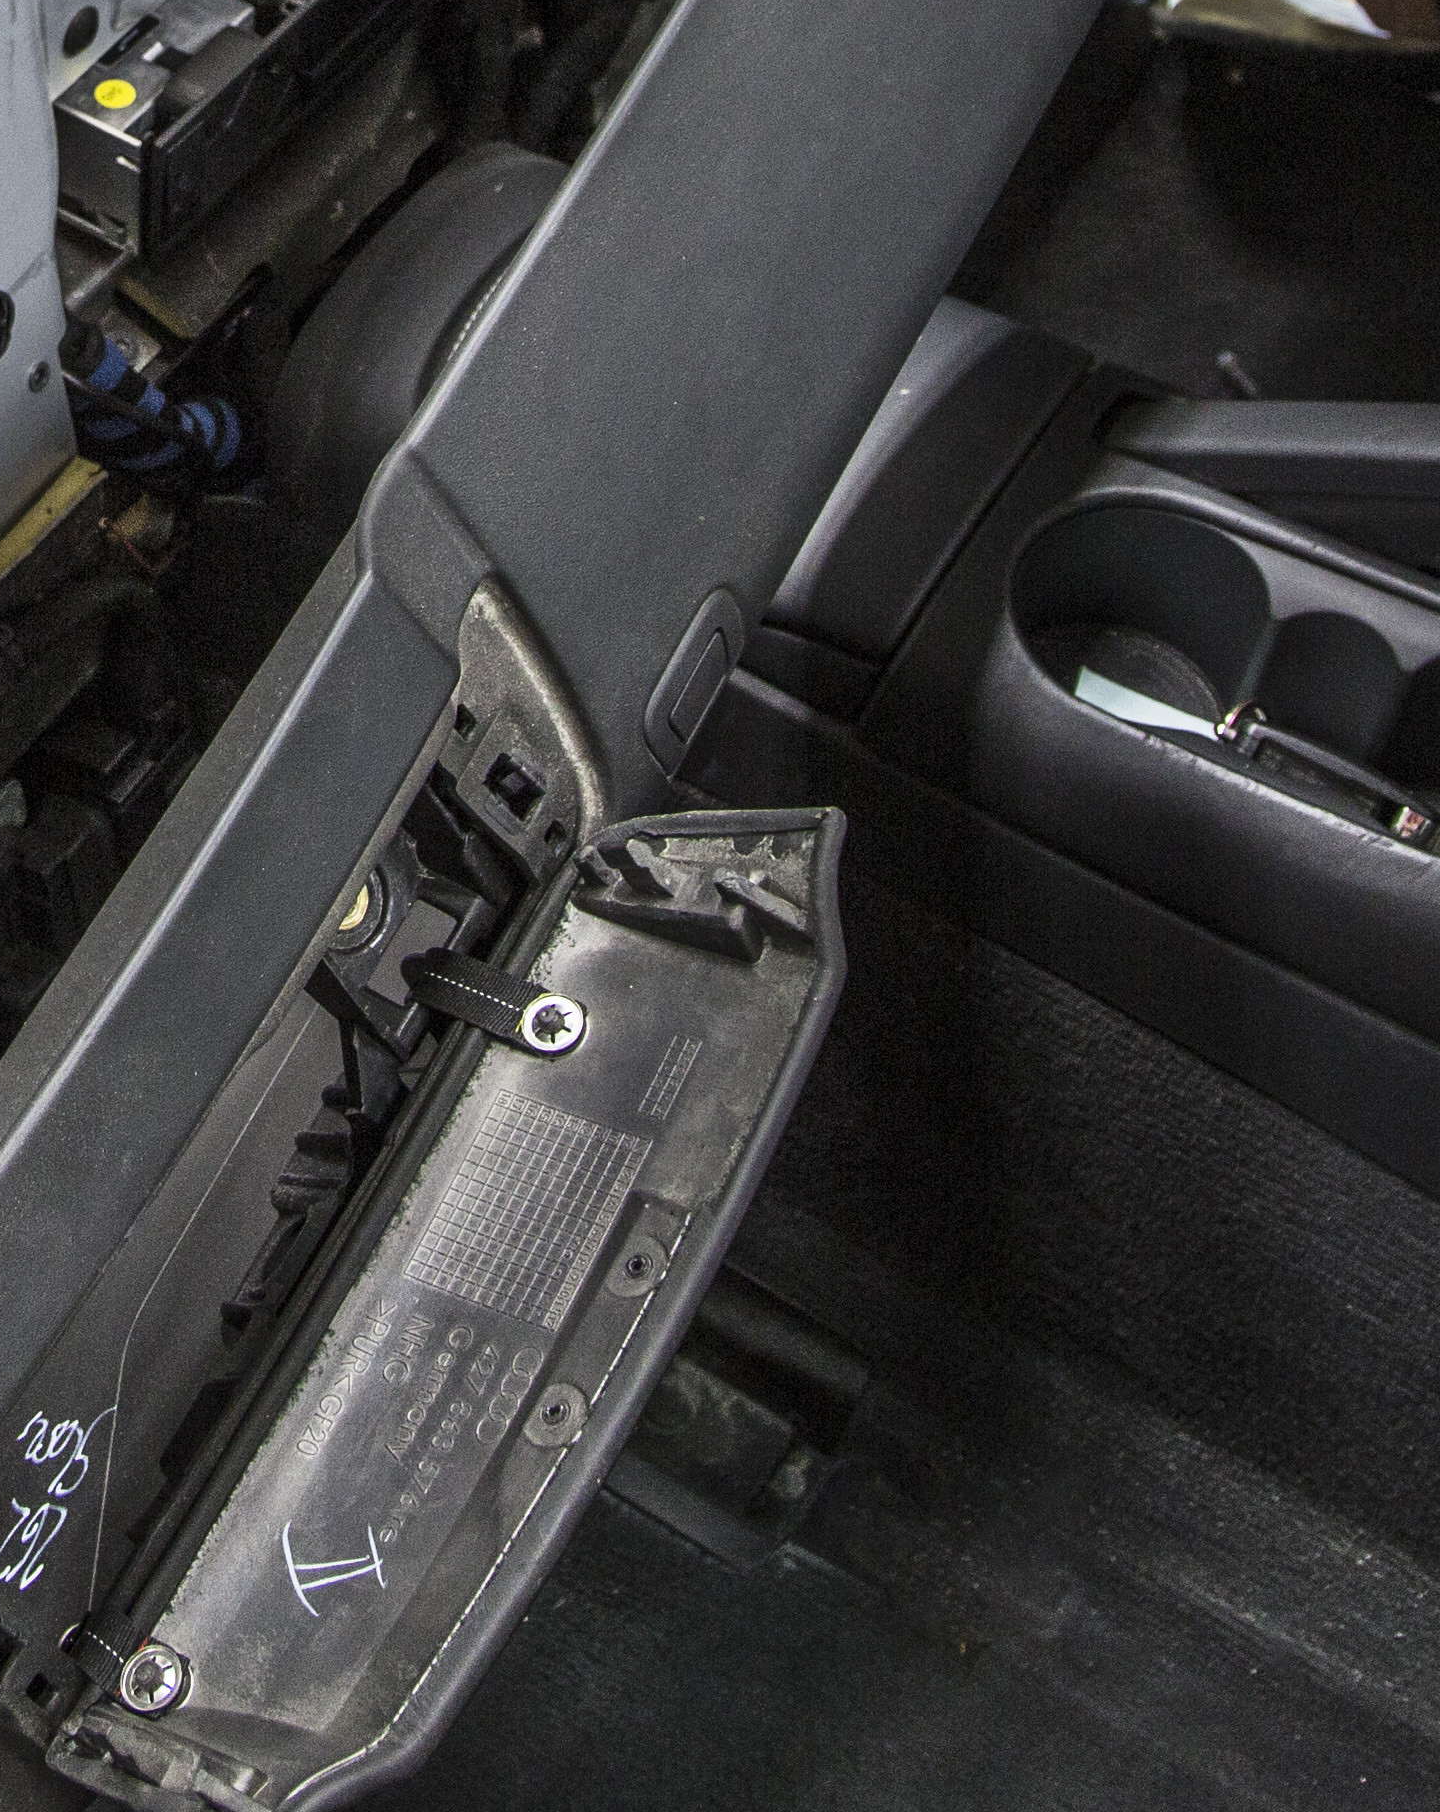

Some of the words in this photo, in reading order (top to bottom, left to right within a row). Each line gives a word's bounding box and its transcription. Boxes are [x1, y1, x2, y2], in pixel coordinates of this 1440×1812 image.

[382, 1315, 435, 1384] NHG
[467, 1344, 499, 1397] 427
[384, 1325, 474, 1465] Germany
